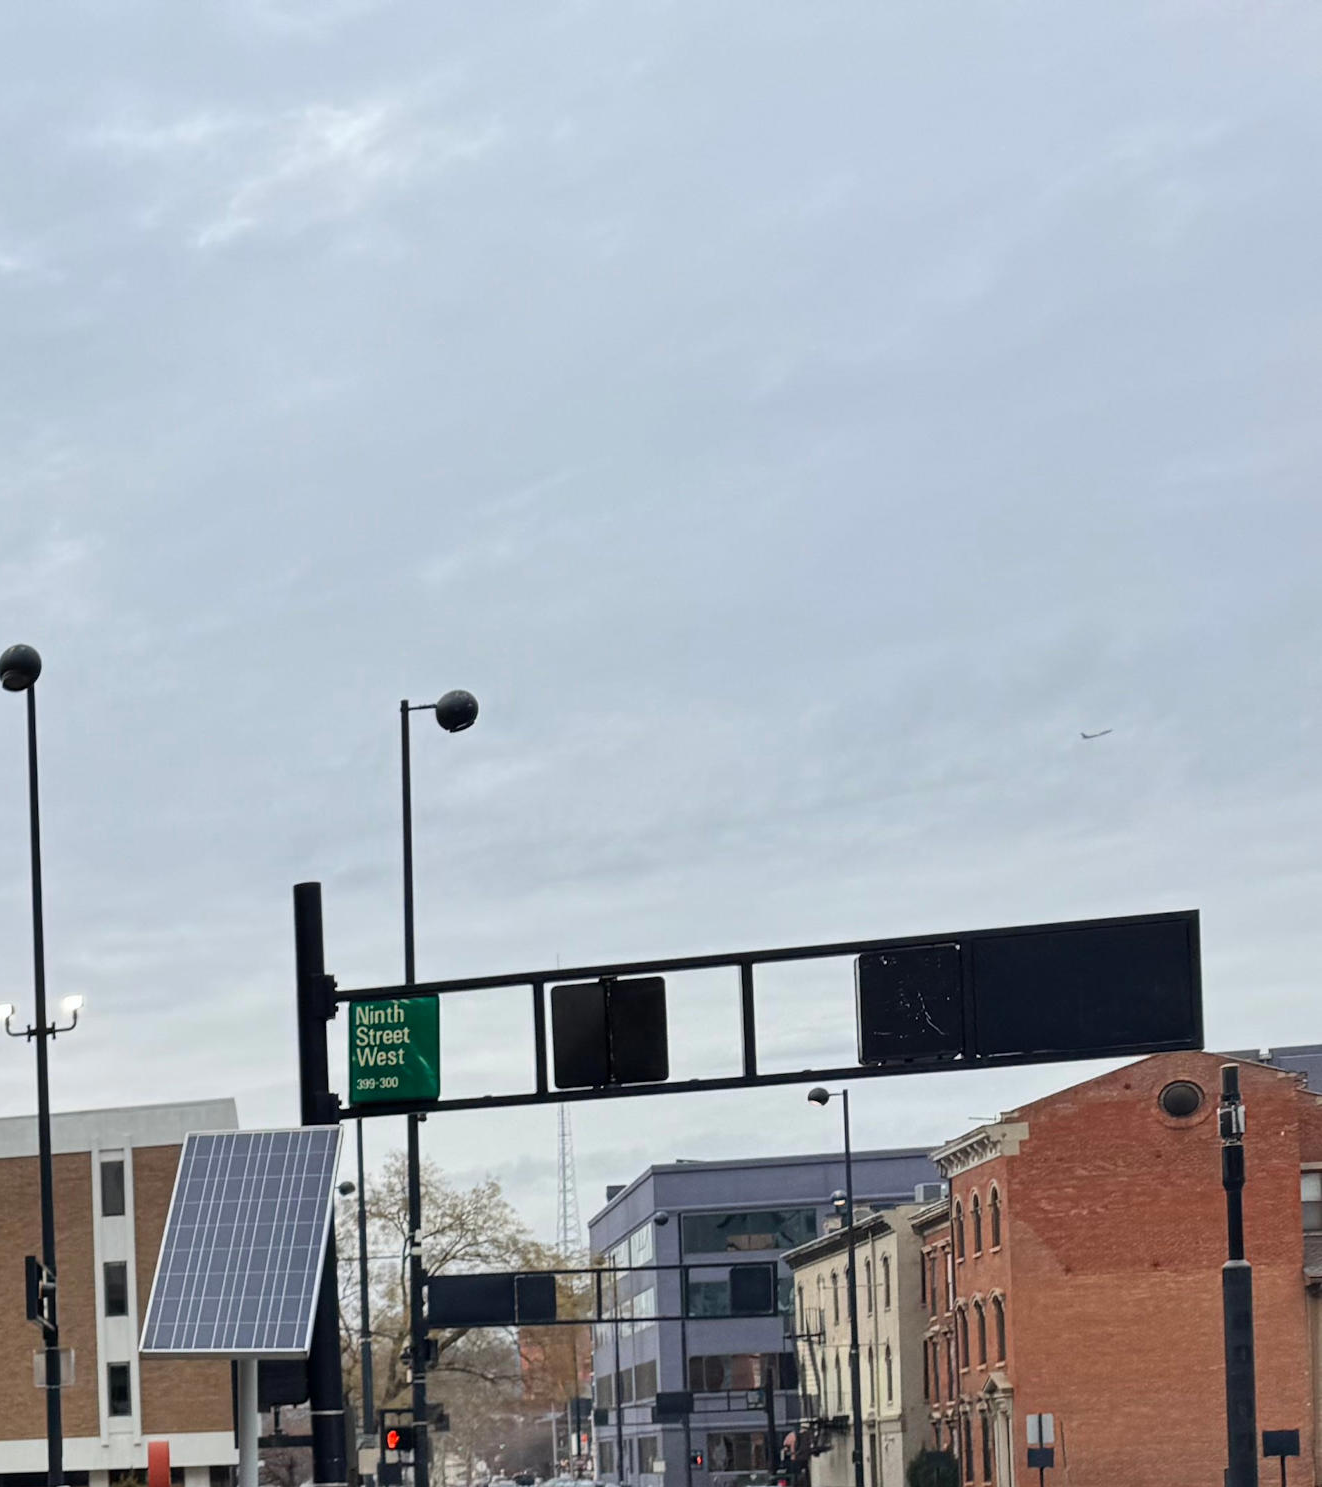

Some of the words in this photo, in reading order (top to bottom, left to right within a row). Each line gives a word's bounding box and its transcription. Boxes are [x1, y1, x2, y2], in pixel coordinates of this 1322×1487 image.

[355, 1001, 405, 1025] Ninth
[356, 1027, 410, 1046] Street
[356, 1048, 405, 1067] West
[356, 1077, 399, 1090] 399-300
